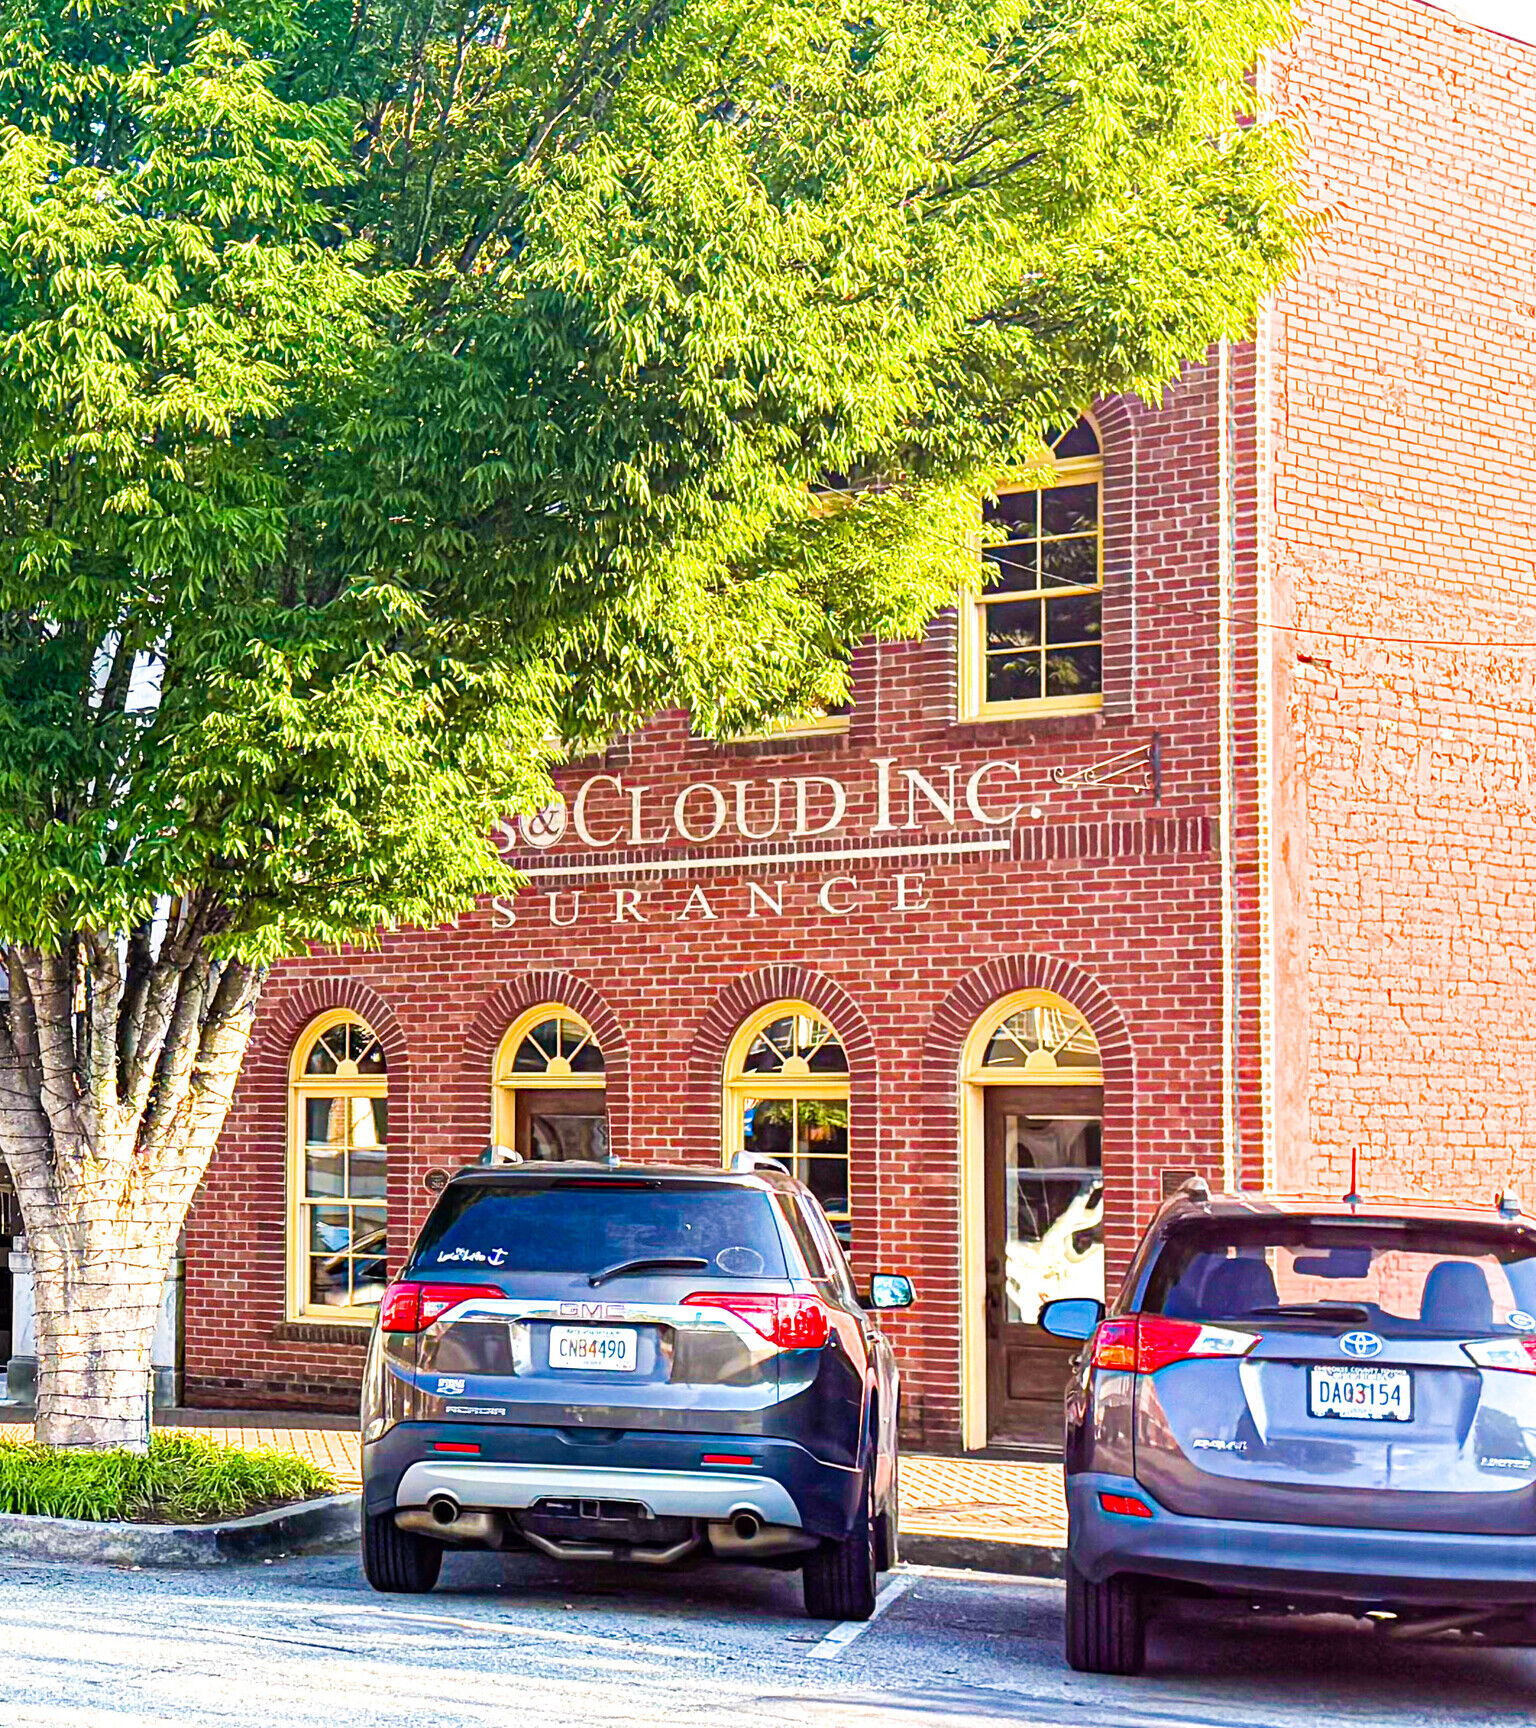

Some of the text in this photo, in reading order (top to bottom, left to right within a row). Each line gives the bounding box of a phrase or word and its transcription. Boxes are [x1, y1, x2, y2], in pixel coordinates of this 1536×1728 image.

[573, 773, 847, 847] CLOUD
[869, 757, 1042, 835] INC.
[386, 872, 931, 933] SURANCE
[559, 1302, 625, 1319] GMC
[559, 1339, 626, 1359] CNB4490
